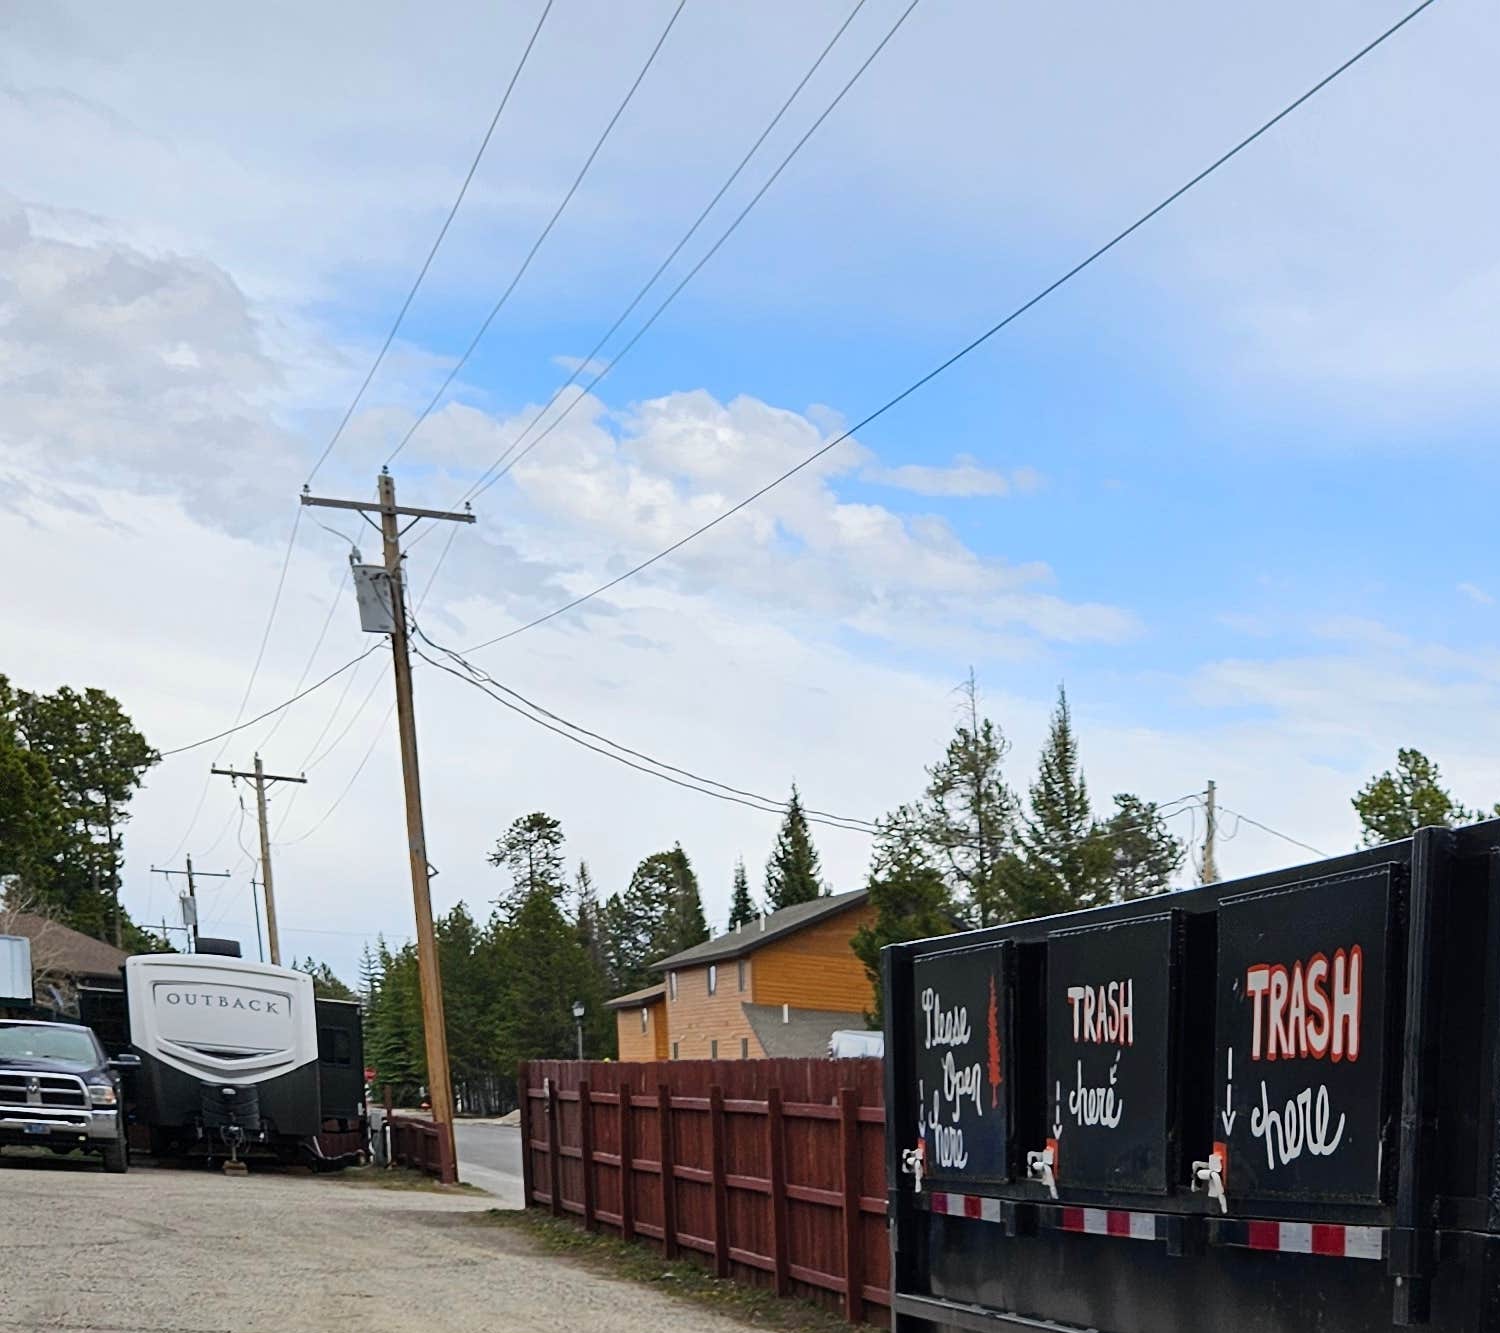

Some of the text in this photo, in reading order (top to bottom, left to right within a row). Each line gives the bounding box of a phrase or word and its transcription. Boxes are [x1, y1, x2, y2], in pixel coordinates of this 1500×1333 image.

[166, 992, 280, 1014] OUTBACK
[921, 987, 971, 1050] Please
[1067, 978, 1134, 1047] TRASH
[1246, 943, 1363, 1063] TRASH
[941, 1051, 983, 1123] Open
[1069, 1059, 1123, 1129] here
[928, 1089, 969, 1170] here
[1250, 1080, 1346, 1170] here
